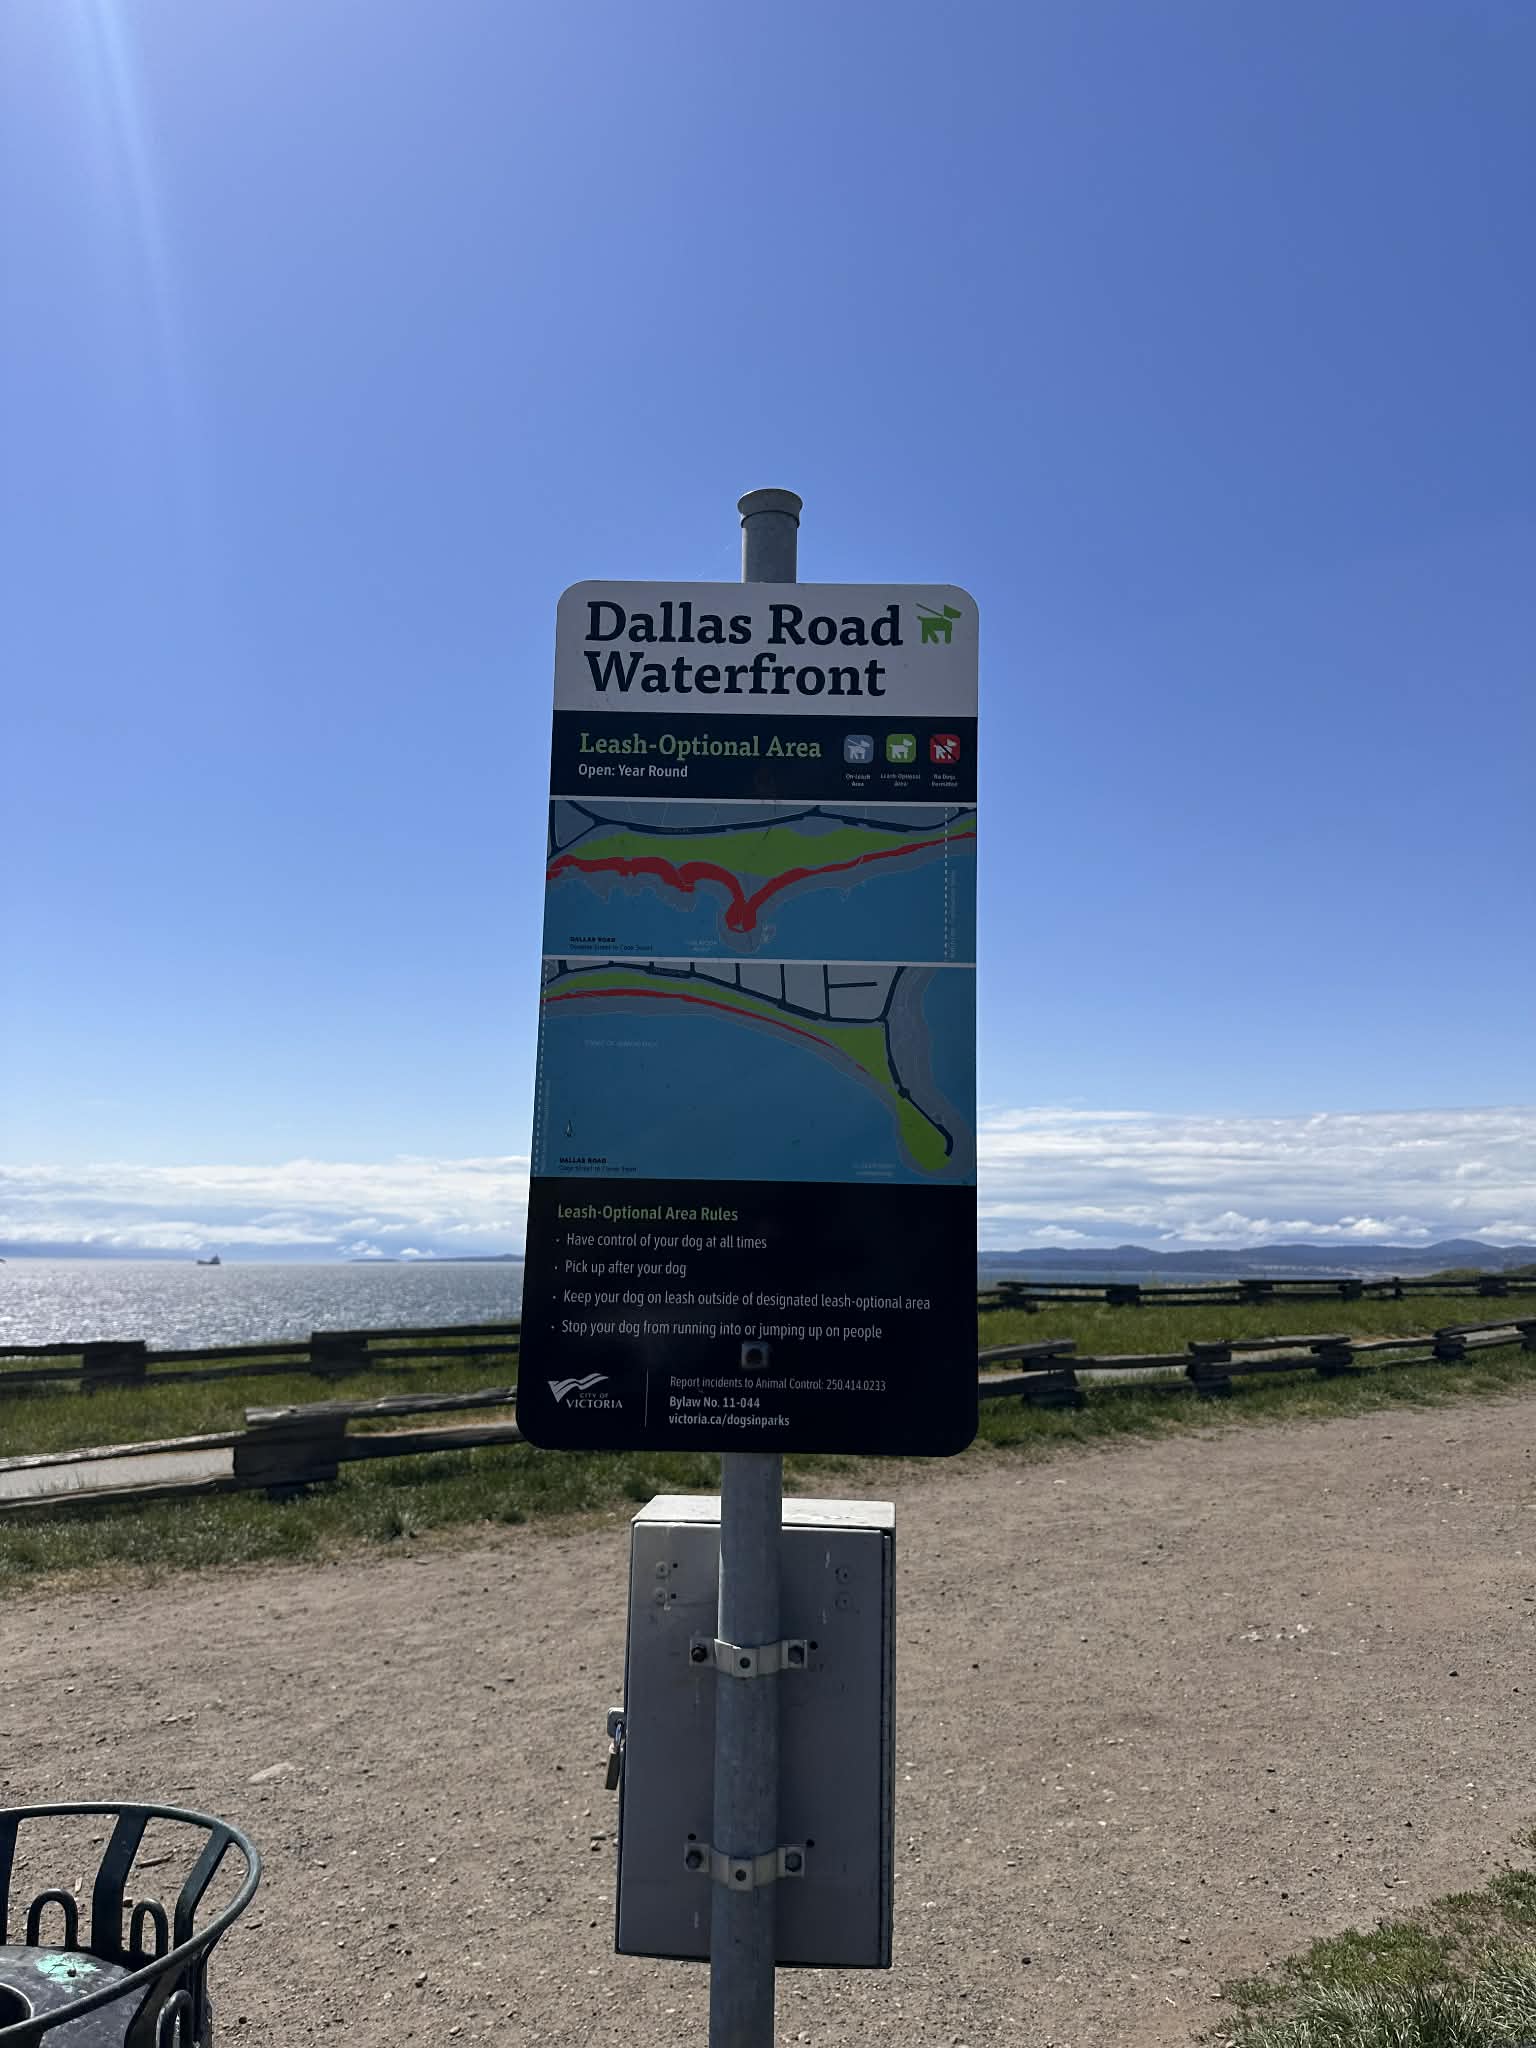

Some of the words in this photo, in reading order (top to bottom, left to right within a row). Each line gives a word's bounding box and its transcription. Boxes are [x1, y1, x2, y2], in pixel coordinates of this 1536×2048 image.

[585, 601, 752, 644] Dallas
[767, 604, 903, 646] Road
[584, 650, 886, 696] Waterfront
[579, 733, 759, 760] Leash-Optional
[766, 736, 822, 757] Area
[578, 764, 615, 777] Open:
[618, 765, 645, 777] Year
[649, 765, 688, 778] Round
[558, 1205, 662, 1222] Leash-Optional
[666, 1206, 697, 1220] Area
[701, 1208, 738, 1221] Rules
[567, 1234, 595, 1247] Have
[598, 1234, 637, 1247] control
[639, 1234, 652, 1248] of
[653, 1236, 679, 1250] your
[682, 1235, 703, 1250] dog
[706, 1237, 717, 1248] at
[720, 1235, 735, 1248] all
[736, 1235, 767, 1249] times
[565, 1261, 588, 1274] Pick
[591, 1264, 605, 1276] up
[608, 1261, 634, 1274] after
[637, 1264, 662, 1277] your
[665, 1262, 686, 1277] dog
[564, 1290, 591, 1305] Keep
[594, 1293, 620, 1306] your
[623, 1291, 644, 1306] dog
[647, 1294, 661, 1305] on
[665, 1291, 695, 1305] leash
[698, 1292, 739, 1306] outside
[742, 1292, 754, 1306] of
[756, 1293, 818, 1309] designated
[821, 1294, 902, 1310] leash-optional
[905, 1297, 930, 1309] area
[561, 1320, 588, 1335] Stop
[590, 1323, 615, 1335] your
[618, 1321, 640, 1336] dog
[643, 1321, 670, 1335] from
[673, 1322, 716, 1337] running
[719, 1323, 741, 1336] into
[745, 1325, 756, 1336] or
[757, 1324, 805, 1339] jumping
[808, 1326, 822, 1339] up
[826, 1326, 840, 1337] on
[843, 1325, 882, 1340] people
[670, 1376, 699, 1390] Report
[702, 1377, 742, 1388] incidents
[744, 1378, 753, 1388] to
[756, 1378, 786, 1390] Animal
[789, 1378, 823, 1390] Control:
[826, 1379, 886, 1391] 250.414.0233
[566, 1399, 623, 1409] VICTORIA
[670, 1396, 700, 1410] Bylaw
[703, 1397, 720, 1408] No.
[723, 1397, 760, 1408] 11-044
[669, 1413, 790, 1427] victoria.ca/dogsinparks
